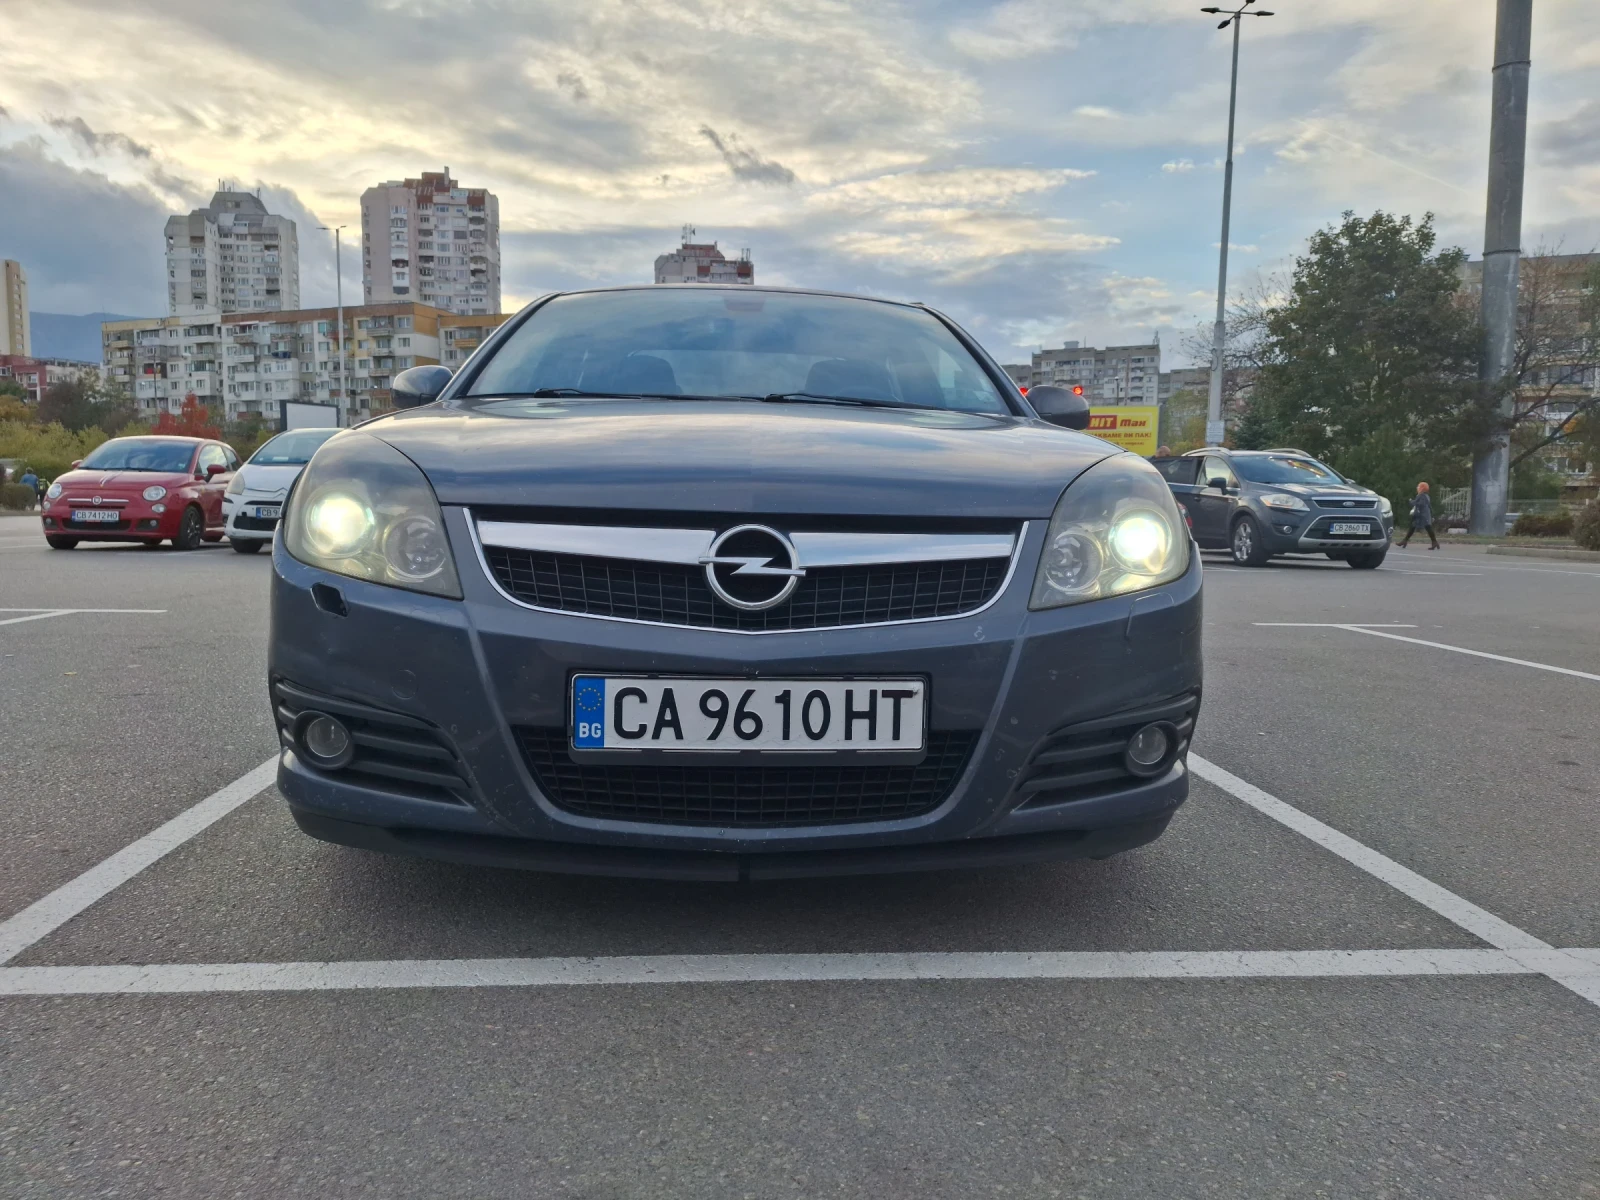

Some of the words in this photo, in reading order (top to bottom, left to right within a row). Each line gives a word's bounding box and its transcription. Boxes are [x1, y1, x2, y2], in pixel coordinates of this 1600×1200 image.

[1090, 417, 1113, 427] HIT
[76, 511, 86, 519] CB
[88, 511, 106, 519] 7412
[613, 687, 684, 740] CA
[699, 688, 832, 741] 9610
[844, 689, 914, 741] HT
[579, 722, 602, 739] BG
